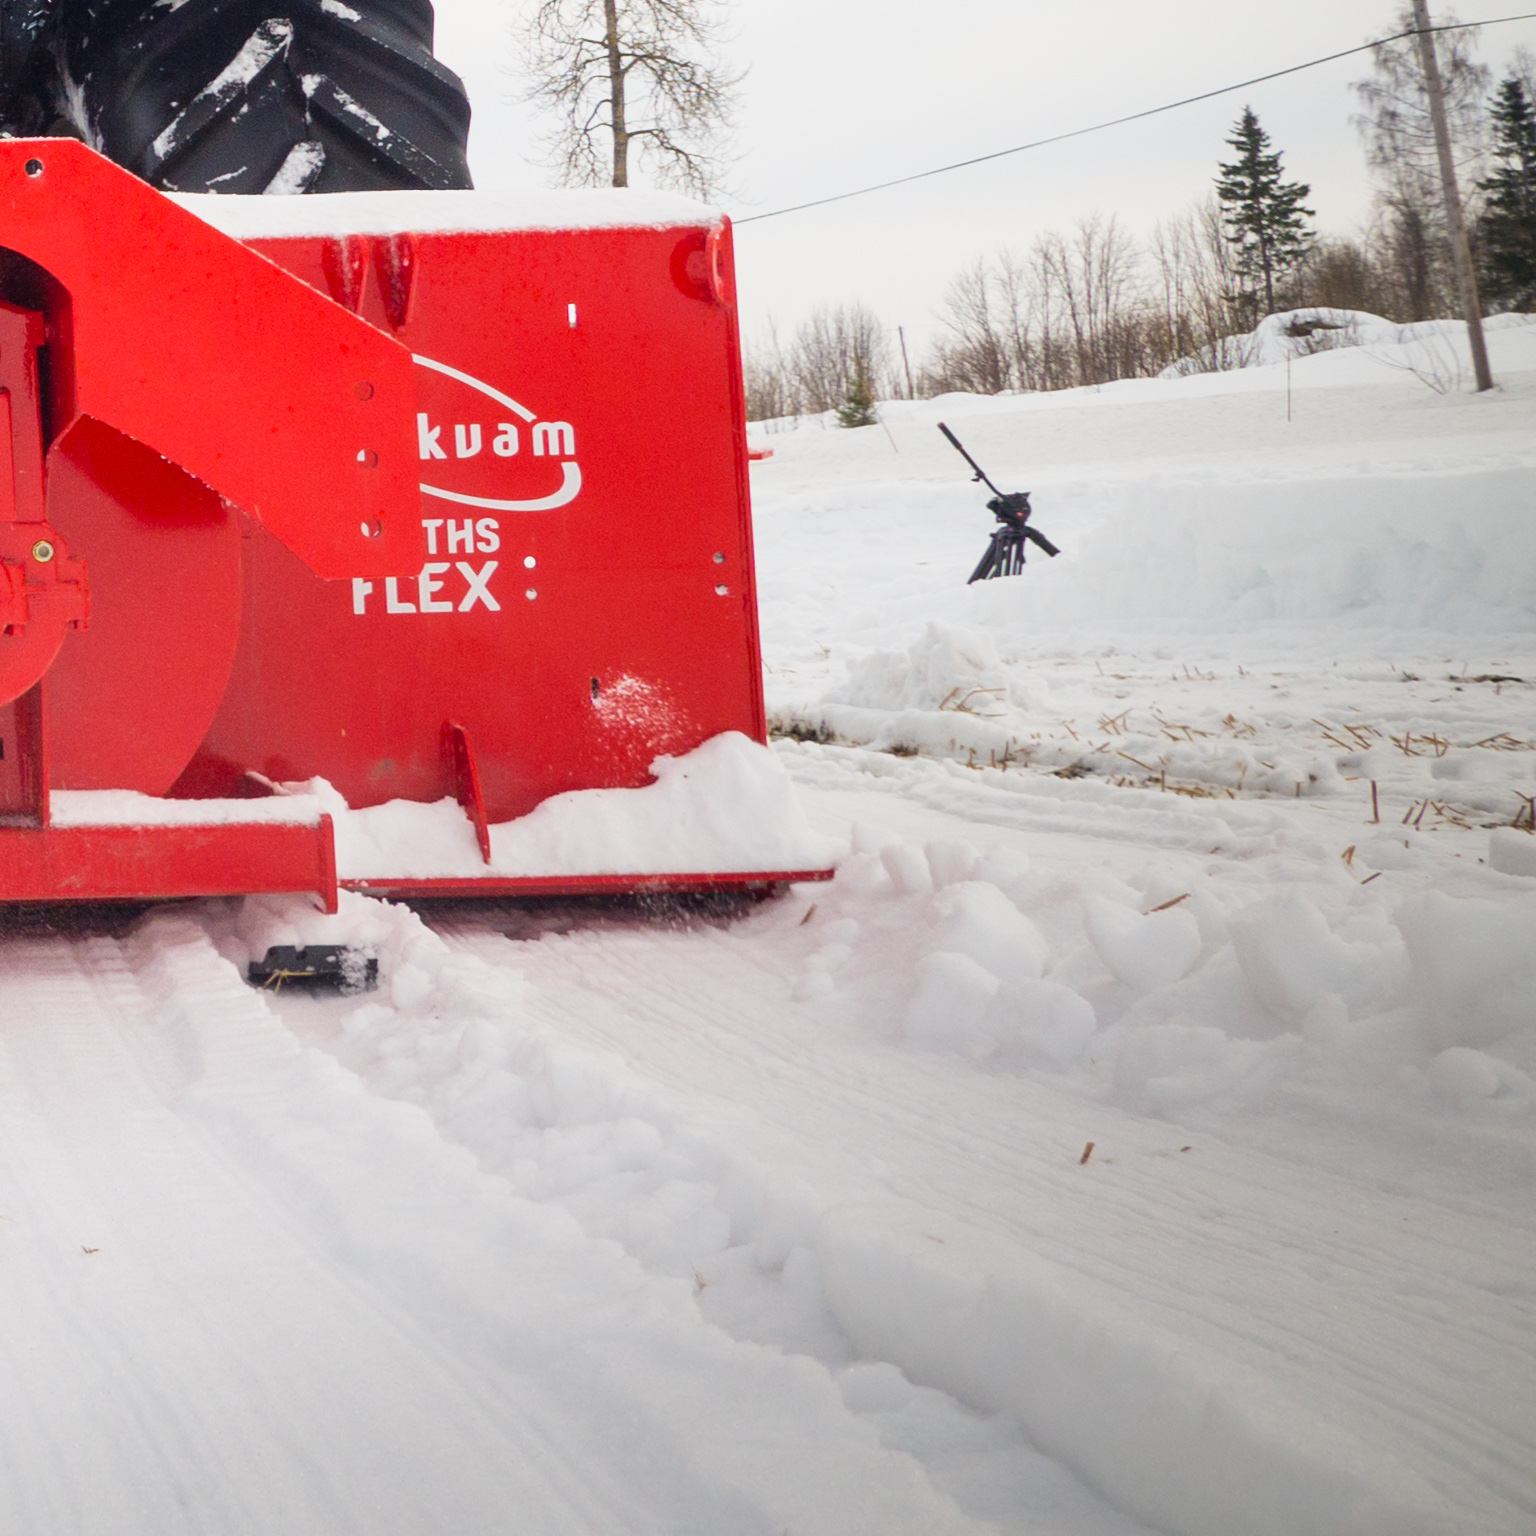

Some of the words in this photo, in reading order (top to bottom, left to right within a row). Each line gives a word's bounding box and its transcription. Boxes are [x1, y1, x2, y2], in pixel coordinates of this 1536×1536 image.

[416, 412, 576, 460] kvam
[421, 517, 501, 555] THS
[352, 560, 501, 615] FLEX
